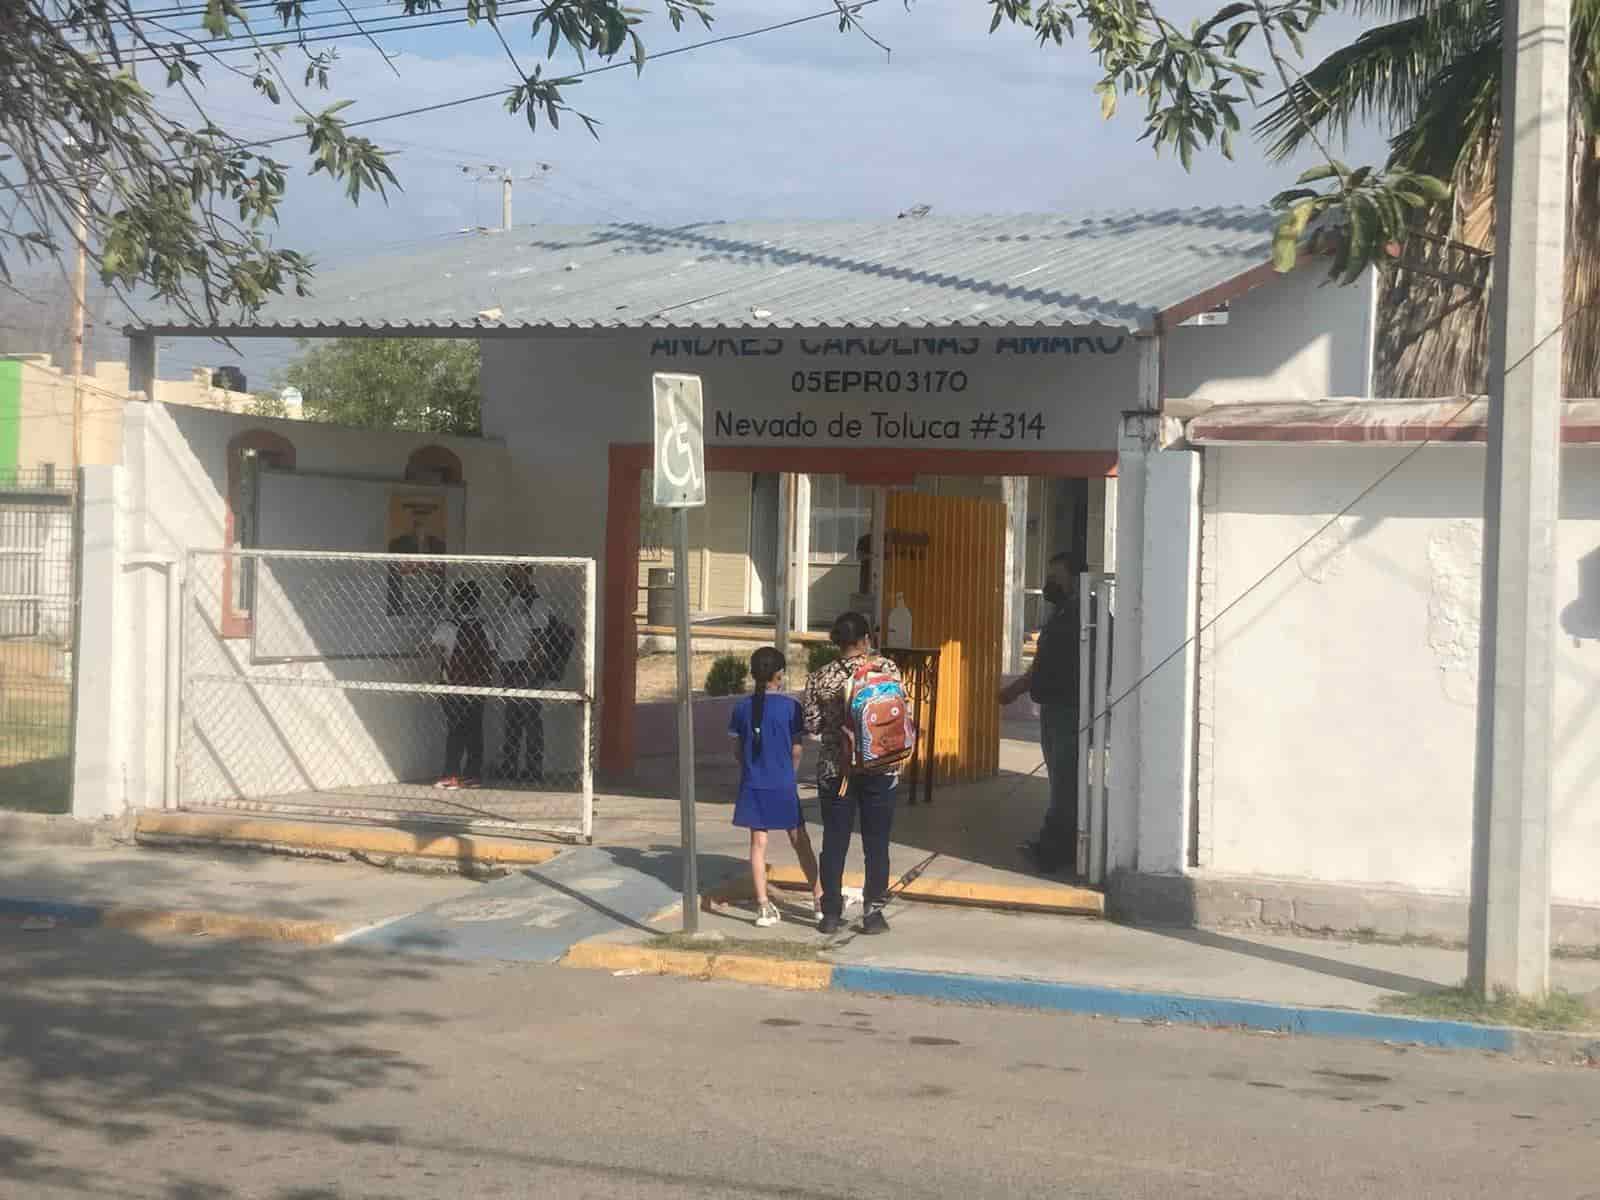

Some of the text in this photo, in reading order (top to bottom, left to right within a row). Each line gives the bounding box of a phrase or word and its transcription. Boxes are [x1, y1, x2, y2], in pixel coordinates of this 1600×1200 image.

[714, 410, 1046, 440] Nevado de Toluca #314
